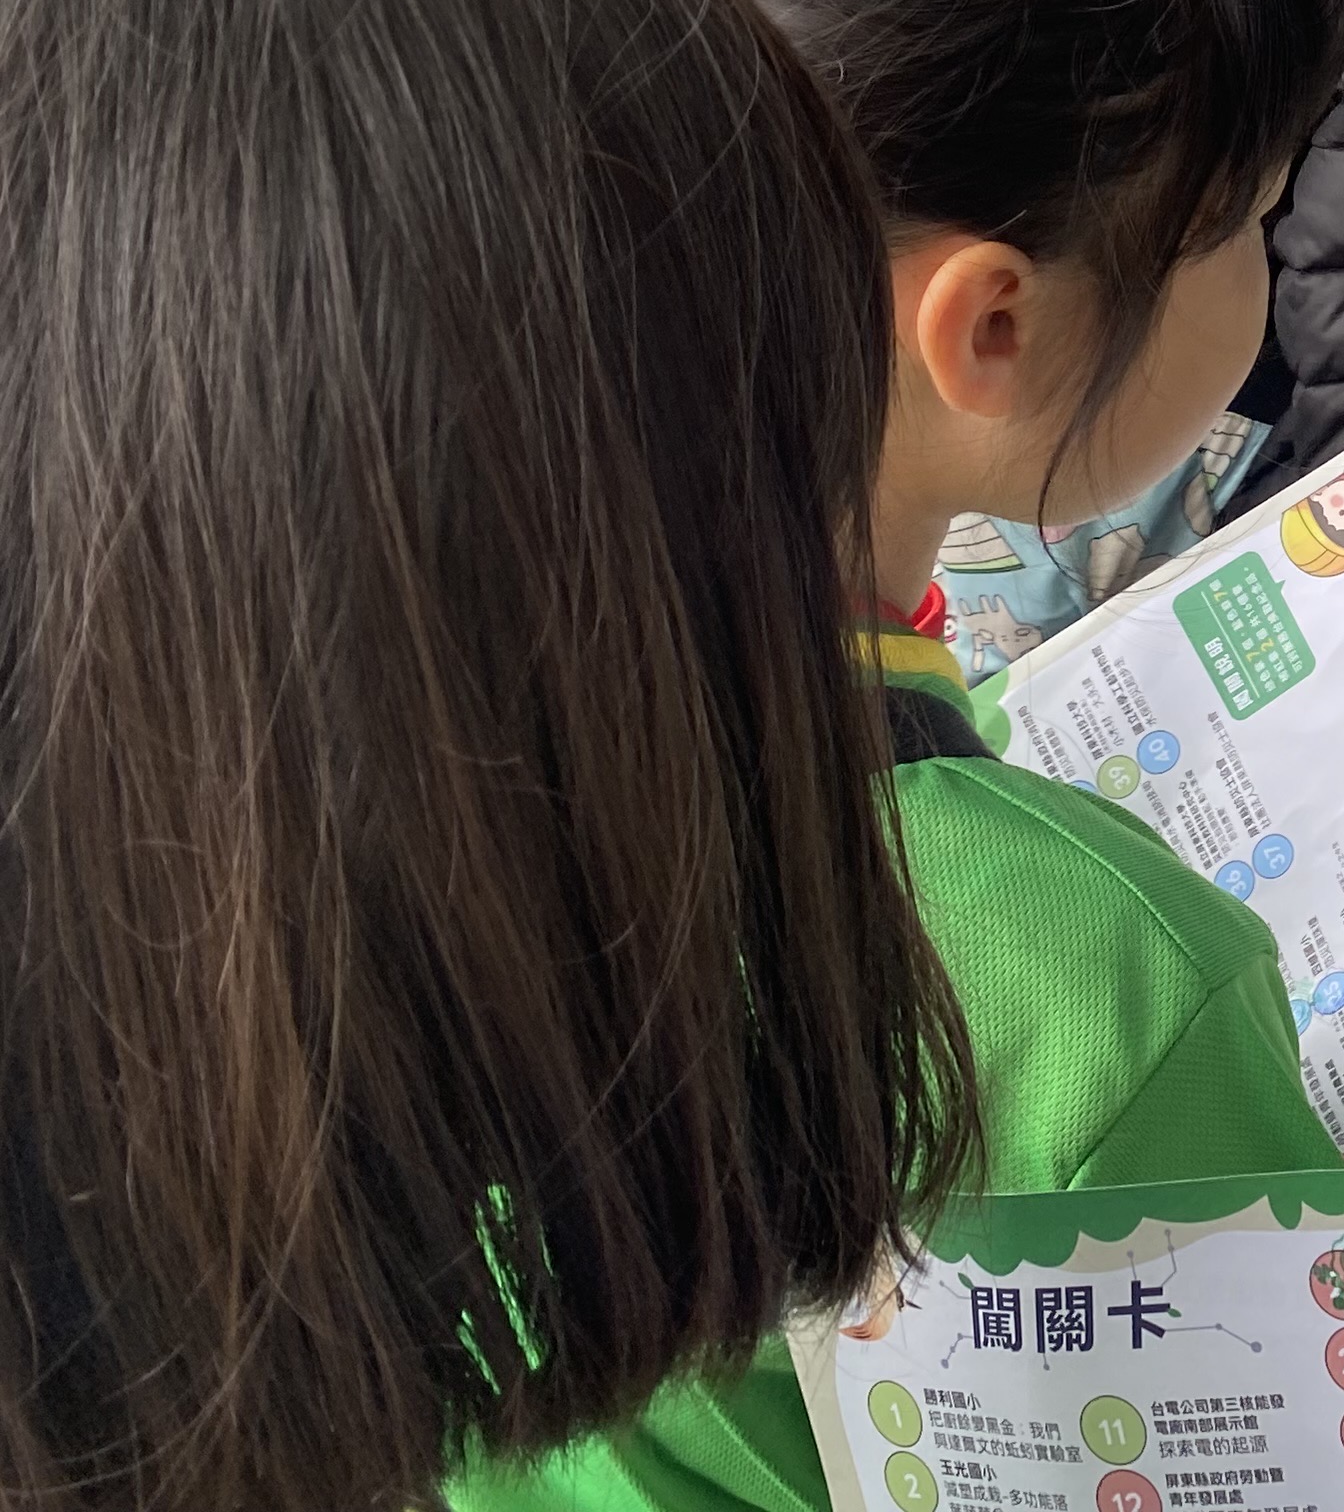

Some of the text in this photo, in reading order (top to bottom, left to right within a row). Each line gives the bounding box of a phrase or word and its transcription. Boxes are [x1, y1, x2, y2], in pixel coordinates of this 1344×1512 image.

[1203, 633, 1253, 712] 闖關說明
[1090, 643, 1145, 736] 國立科學工藝博物館
[1112, 655, 1157, 727] 水保防災起步走
[1066, 698, 1103, 760] 屏東科技大學
[1147, 735, 1171, 766] 40
[1107, 760, 1131, 791] 39
[1205, 709, 1272, 830] 社團法人屏東縣防災士協會
[1214, 755, 1259, 839] 屏東縣防災士協會
[1262, 840, 1286, 870] 37
[1223, 865, 1247, 898] 36
[1322, 979, 1343, 1005] 25
[971, 1281, 1170, 1353] 闖關卡
[924, 1388, 981, 1410] 勝利國小
[1151, 1394, 1284, 1417] 台電公司第三核能發
[890, 1403, 902, 1428] 1
[1154, 1415, 1259, 1435] 電廠南部展示館
[1099, 1418, 1126, 1445] 11
[934, 1432, 1083, 1463] 與達爾文的蚯蚓實驗室
[1159, 1435, 1269, 1459] 探索電的起源
[939, 1460, 997, 1481] 玉光國小
[1165, 1468, 1284, 1488] 屏東縣政府勞動暨
[904, 1474, 921, 1499] 2
[1169, 1489, 1244, 1506] 青年發展處
[1112, 1493, 1142, 1512] 12
